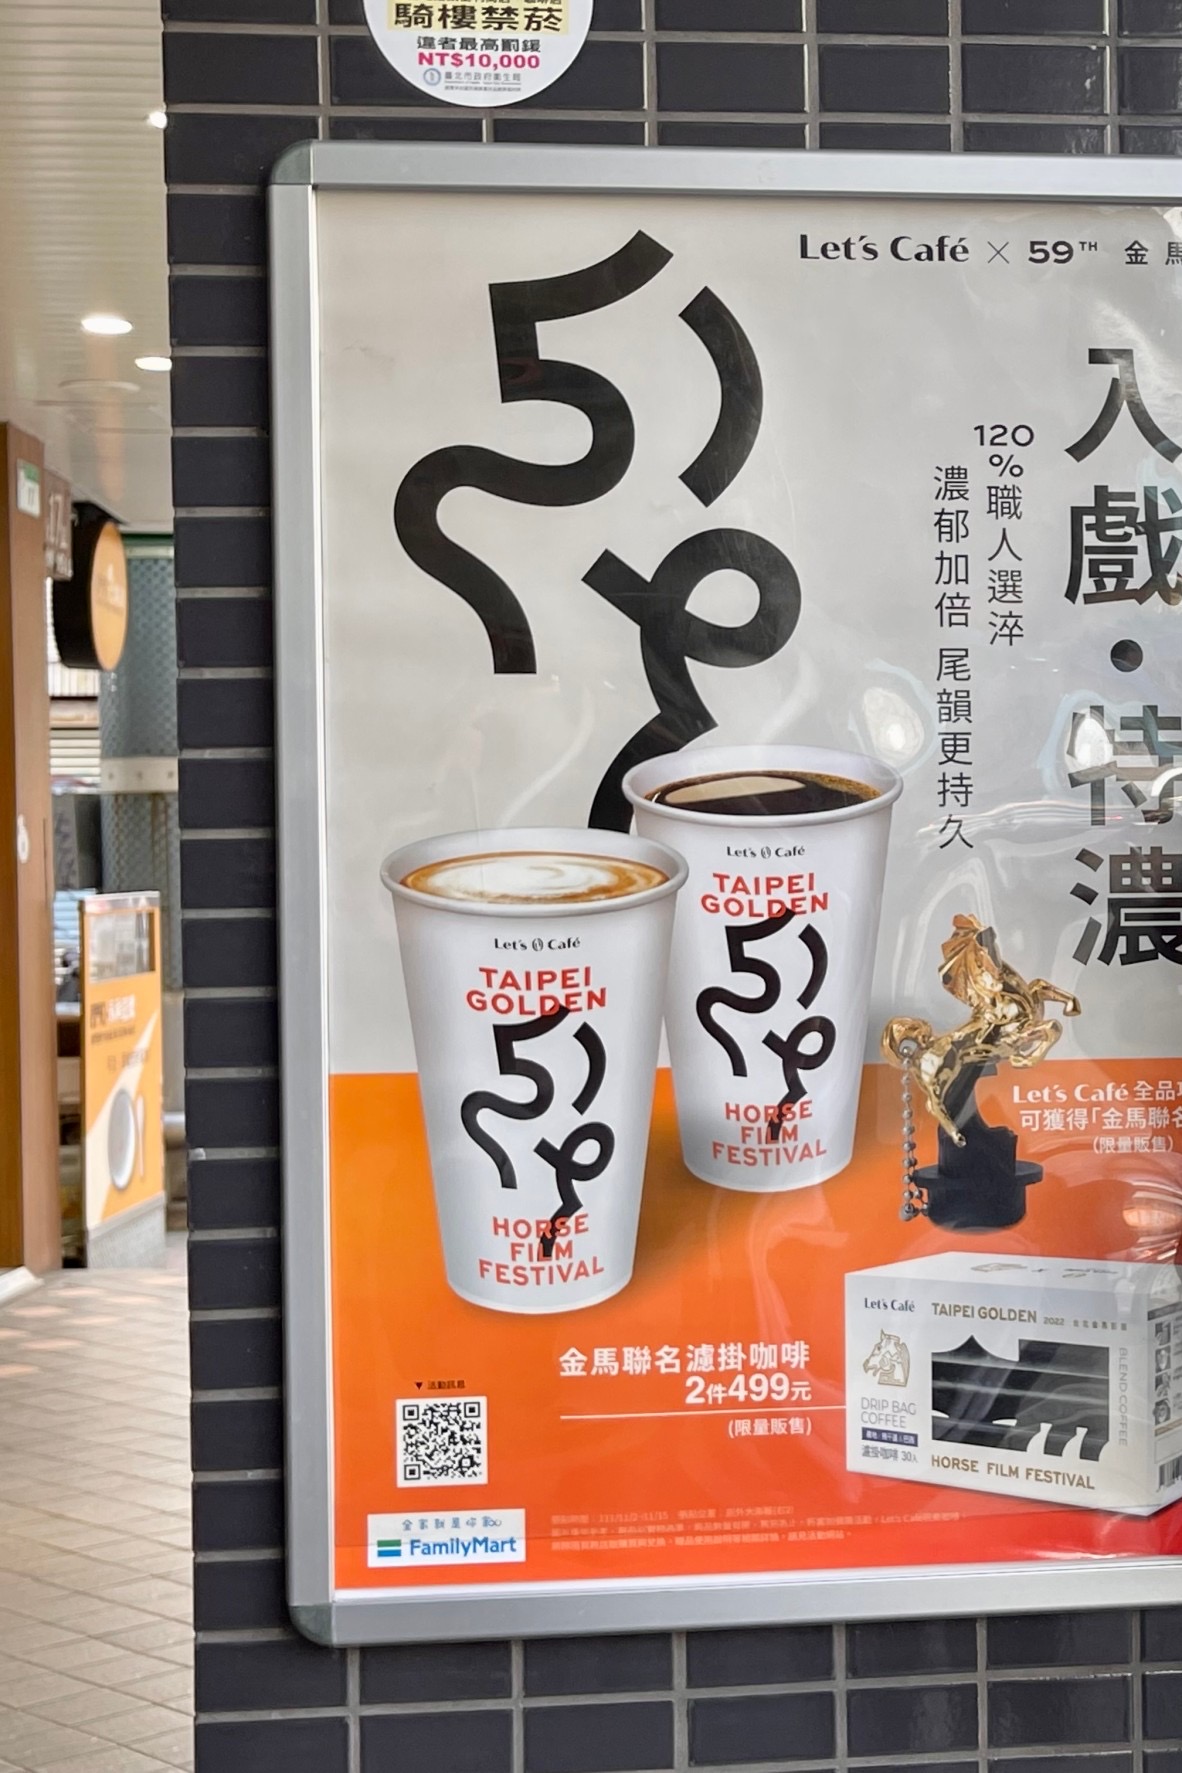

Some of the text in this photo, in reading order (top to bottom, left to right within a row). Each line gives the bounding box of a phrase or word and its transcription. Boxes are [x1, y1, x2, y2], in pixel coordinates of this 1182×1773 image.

[394, 3, 562, 32] 騎樓禁菸
[416, 36, 541, 53] 違者最高罰鍰
[418, 52, 540, 71] NT$10,000
[799, 233, 879, 261] Let's
[890, 235, 970, 263] Café
[933, 466, 974, 850] 濃郁加倍 尾韻更持久
[726, 845, 805, 859] Let's Café
[712, 872, 815, 896] TAIPEI
[700, 892, 829, 919] GOLDEN
[494, 937, 581, 951] Let's Café
[478, 966, 592, 991] TAIPEI
[465, 987, 607, 1017] GOLDEN
[1013, 1084, 1068, 1104] Let's
[1074, 1081, 1130, 1103] Café
[725, 1099, 813, 1124] HORSE
[740, 1124, 799, 1145] FILM
[1092, 1135, 1174, 1155] (限量販售)
[711, 1138, 827, 1168] FESTIVAL
[492, 1213, 590, 1239] HORSE
[509, 1239, 574, 1263] FILM
[478, 1255, 605, 1287] FESTIVAL
[864, 1296, 916, 1313] Let's Café
[931, 1302, 975, 1319] TAIPEI
[977, 1305, 1037, 1324] GOLDEN
[1043, 1316, 1065, 1326] 2022
[558, 1340, 811, 1378] 金馬聯名濾掛咖啡
[684, 1372, 813, 1405] 2件499元
[1118, 1346, 1129, 1448] BLEND COFFEE
[861, 1396, 917, 1416] DRIP BAG
[728, 1416, 813, 1439] (限量販售)
[861, 1411, 907, 1429] COFFEE
[931, 1454, 1096, 1491] HORSE FILM FESTIVAL
[410, 1536, 517, 1557] FamilyMart
